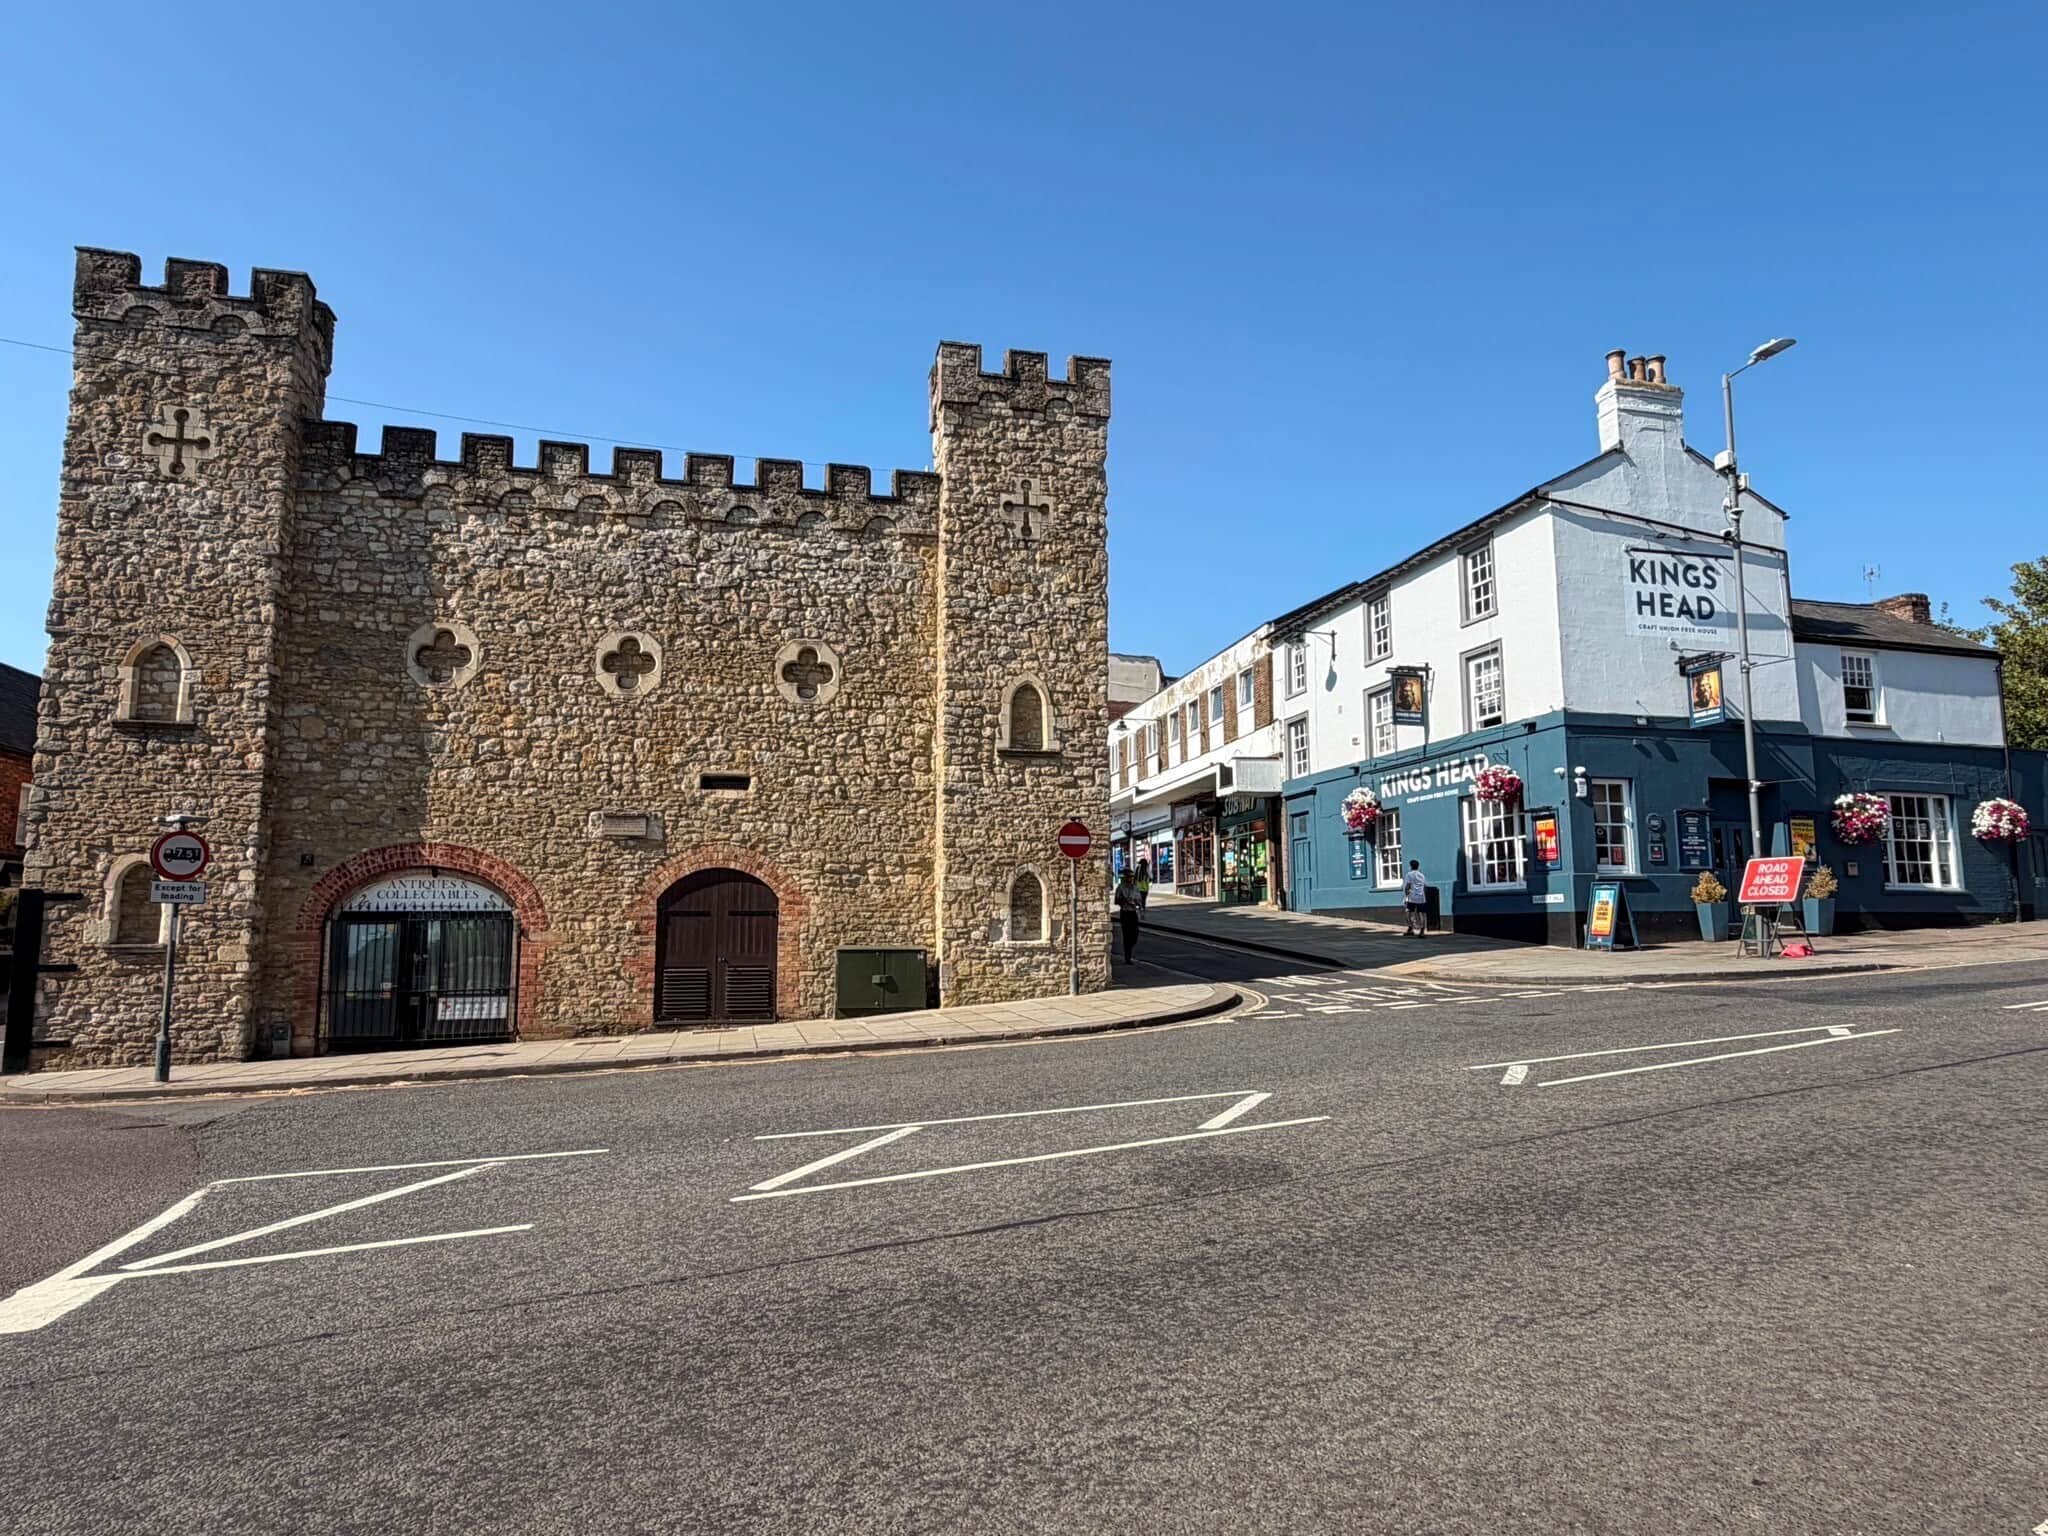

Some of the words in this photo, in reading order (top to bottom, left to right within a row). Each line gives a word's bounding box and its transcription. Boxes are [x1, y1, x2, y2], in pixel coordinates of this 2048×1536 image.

[1629, 558, 1718, 590] KINGS
[1636, 590, 1715, 620] HEAD
[1638, 623, 1657, 631] CRAFT
[1380, 766, 1432, 799] KINGS
[1436, 753, 1489, 787] HEAD
[1758, 863, 1788, 873] ROAD
[387, 879, 457, 890] ANTIQUES
[460, 880, 469, 889] &
[1752, 874, 1788, 884] AHEAD
[155, 883, 185, 892] Except
[188, 884, 202, 892] for
[1747, 885, 1789, 896] CLOSED
[160, 892, 194, 901] loading
[377, 889, 480, 900] COLLECTABLES
[1254, 975, 1348, 987] NO
